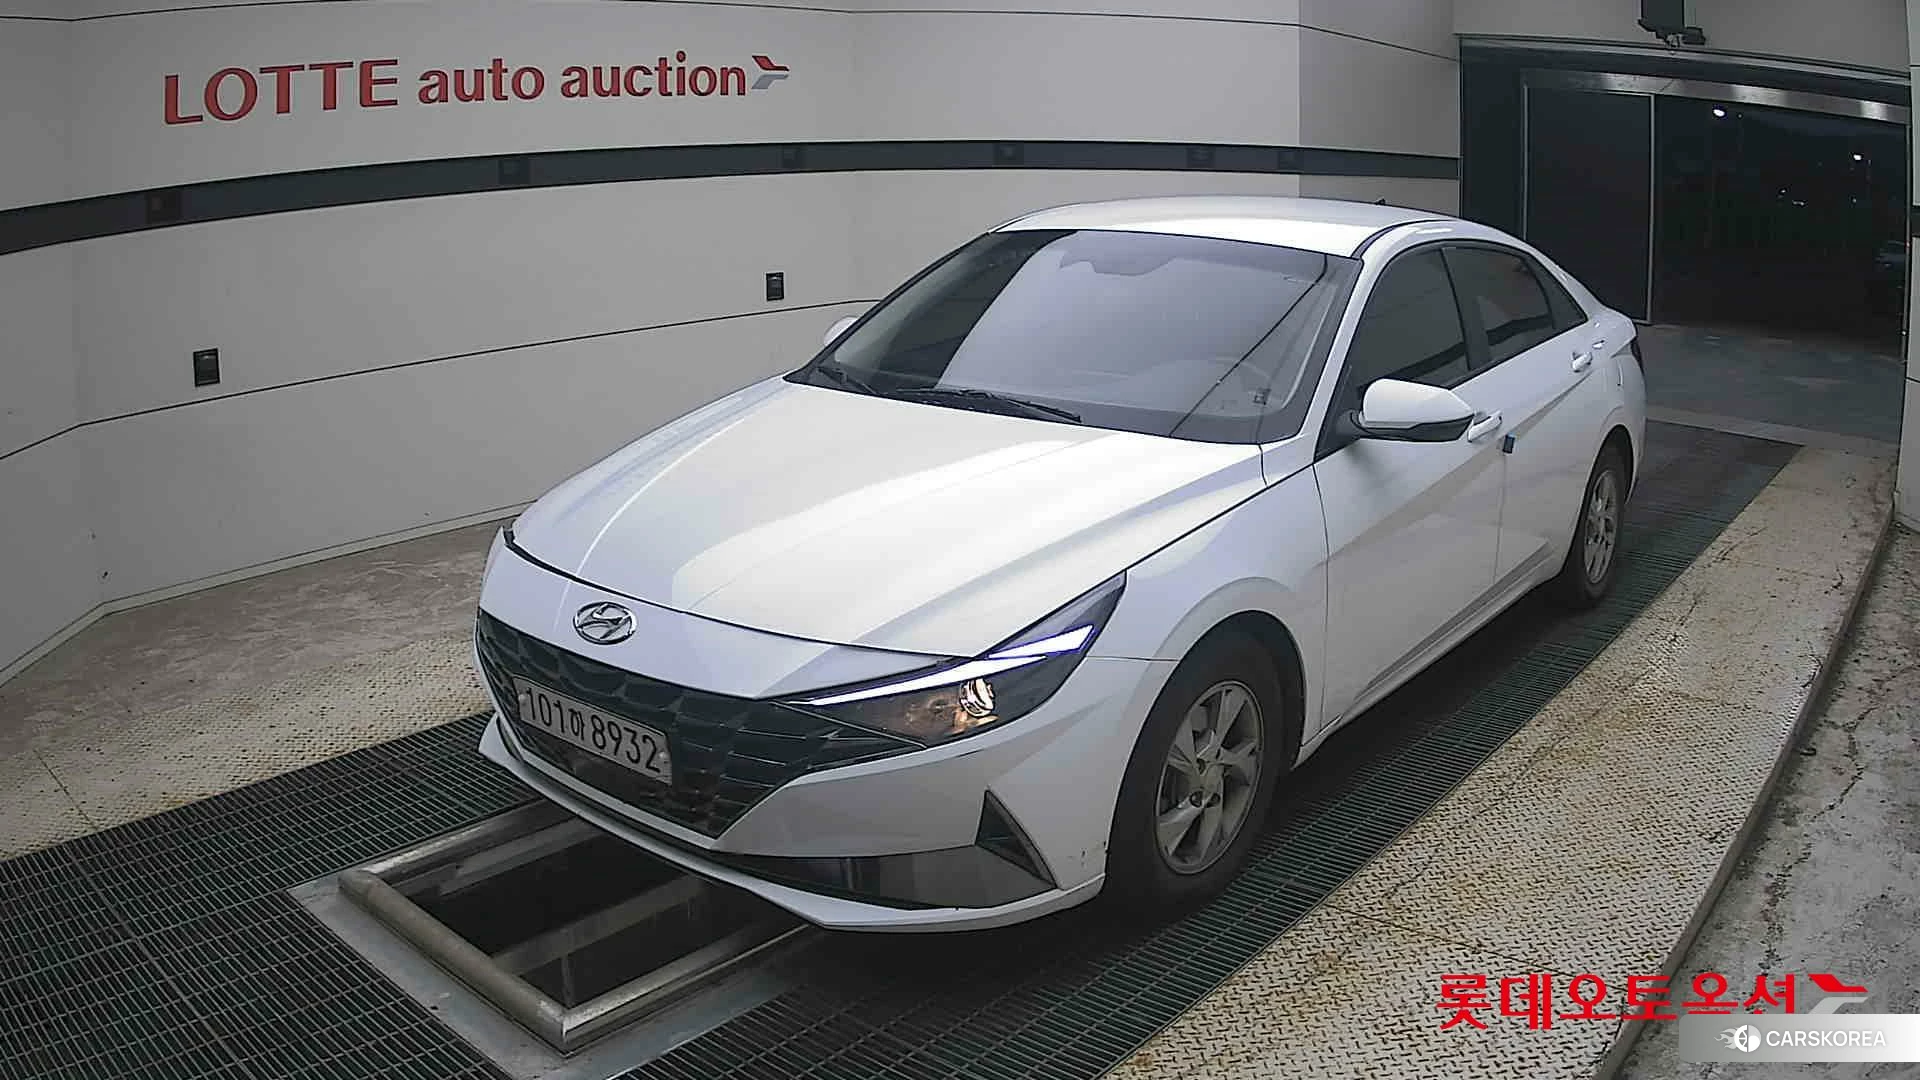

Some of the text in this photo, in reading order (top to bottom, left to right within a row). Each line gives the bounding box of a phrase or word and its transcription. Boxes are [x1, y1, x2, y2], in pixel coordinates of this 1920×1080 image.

[164, 50, 747, 125] LOTTE auto auction
[591, 714, 661, 773] 8932
